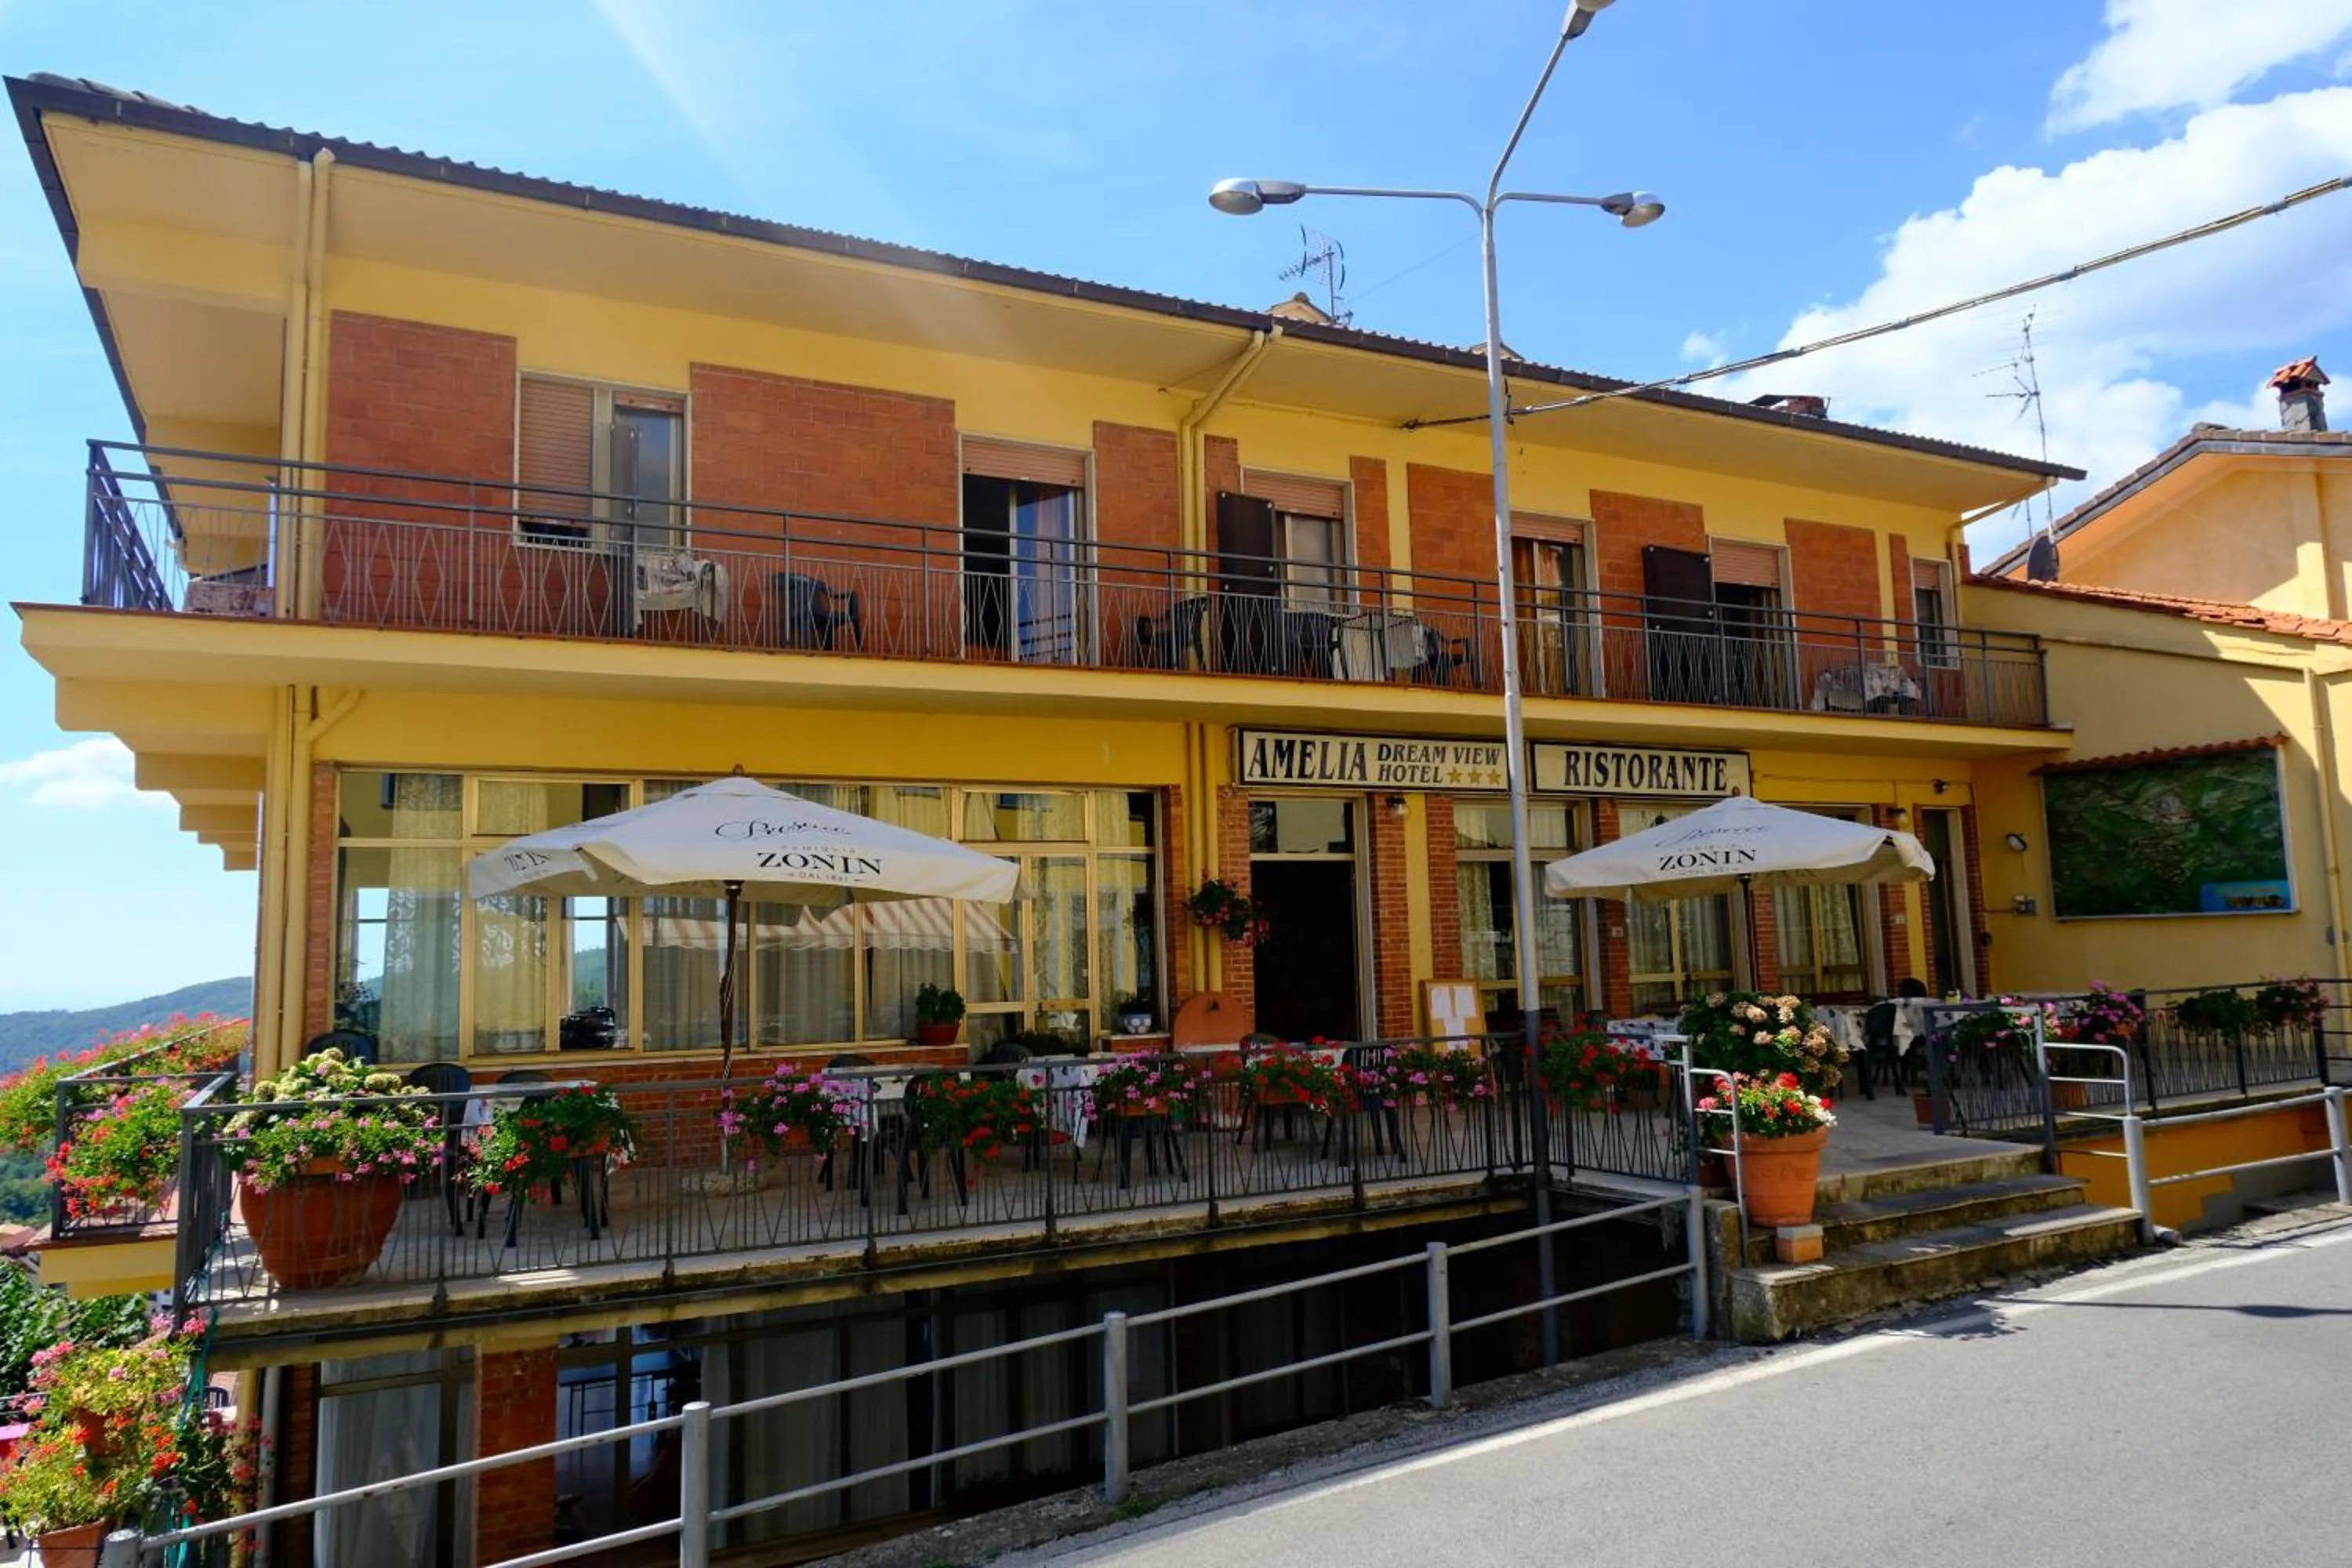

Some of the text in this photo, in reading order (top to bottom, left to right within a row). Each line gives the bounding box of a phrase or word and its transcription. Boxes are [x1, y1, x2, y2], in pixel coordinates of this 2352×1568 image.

[1247, 738, 1368, 782] AMELIA
[1377, 744, 1501, 766] DREAM VIEW
[1377, 764, 1443, 783] HOTEL
[1563, 750, 1728, 791] RISTORANTE
[757, 851, 882, 875] ZONIN
[1659, 848, 1757, 871] ZONIN
